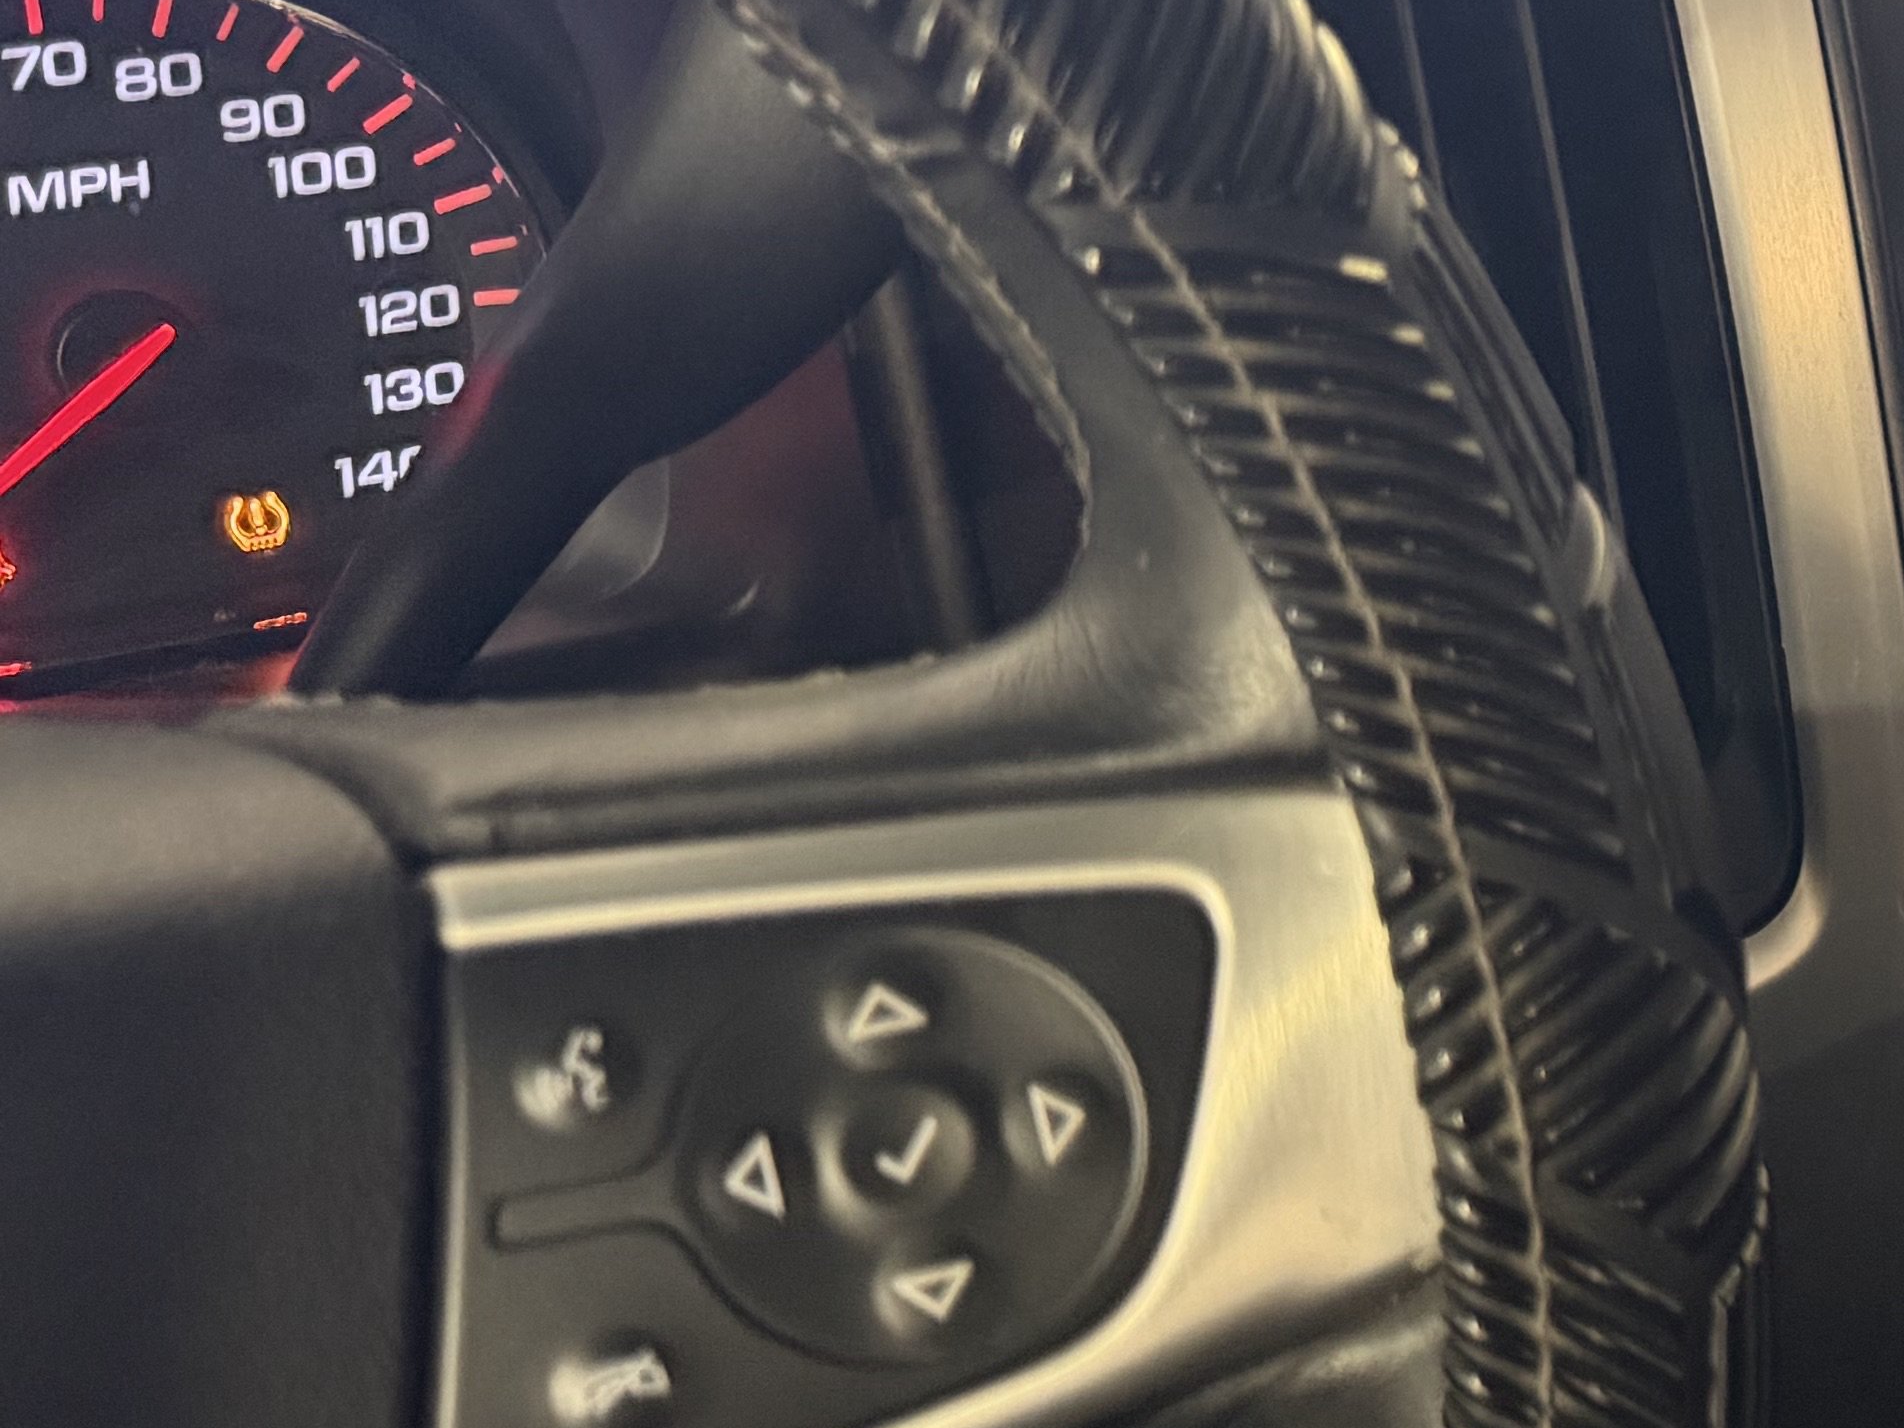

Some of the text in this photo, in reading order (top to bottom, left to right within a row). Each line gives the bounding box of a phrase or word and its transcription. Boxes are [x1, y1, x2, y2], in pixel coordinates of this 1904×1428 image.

[2, 41, 86, 90] 70
[115, 53, 202, 101] 80
[221, 94, 304, 142] 90
[8, 160, 149, 215] MPH
[268, 146, 375, 198] 100
[345, 212, 429, 260] 110
[359, 285, 459, 336] 120
[364, 362, 464, 414] 130
[335, 445, 421, 497] 14
